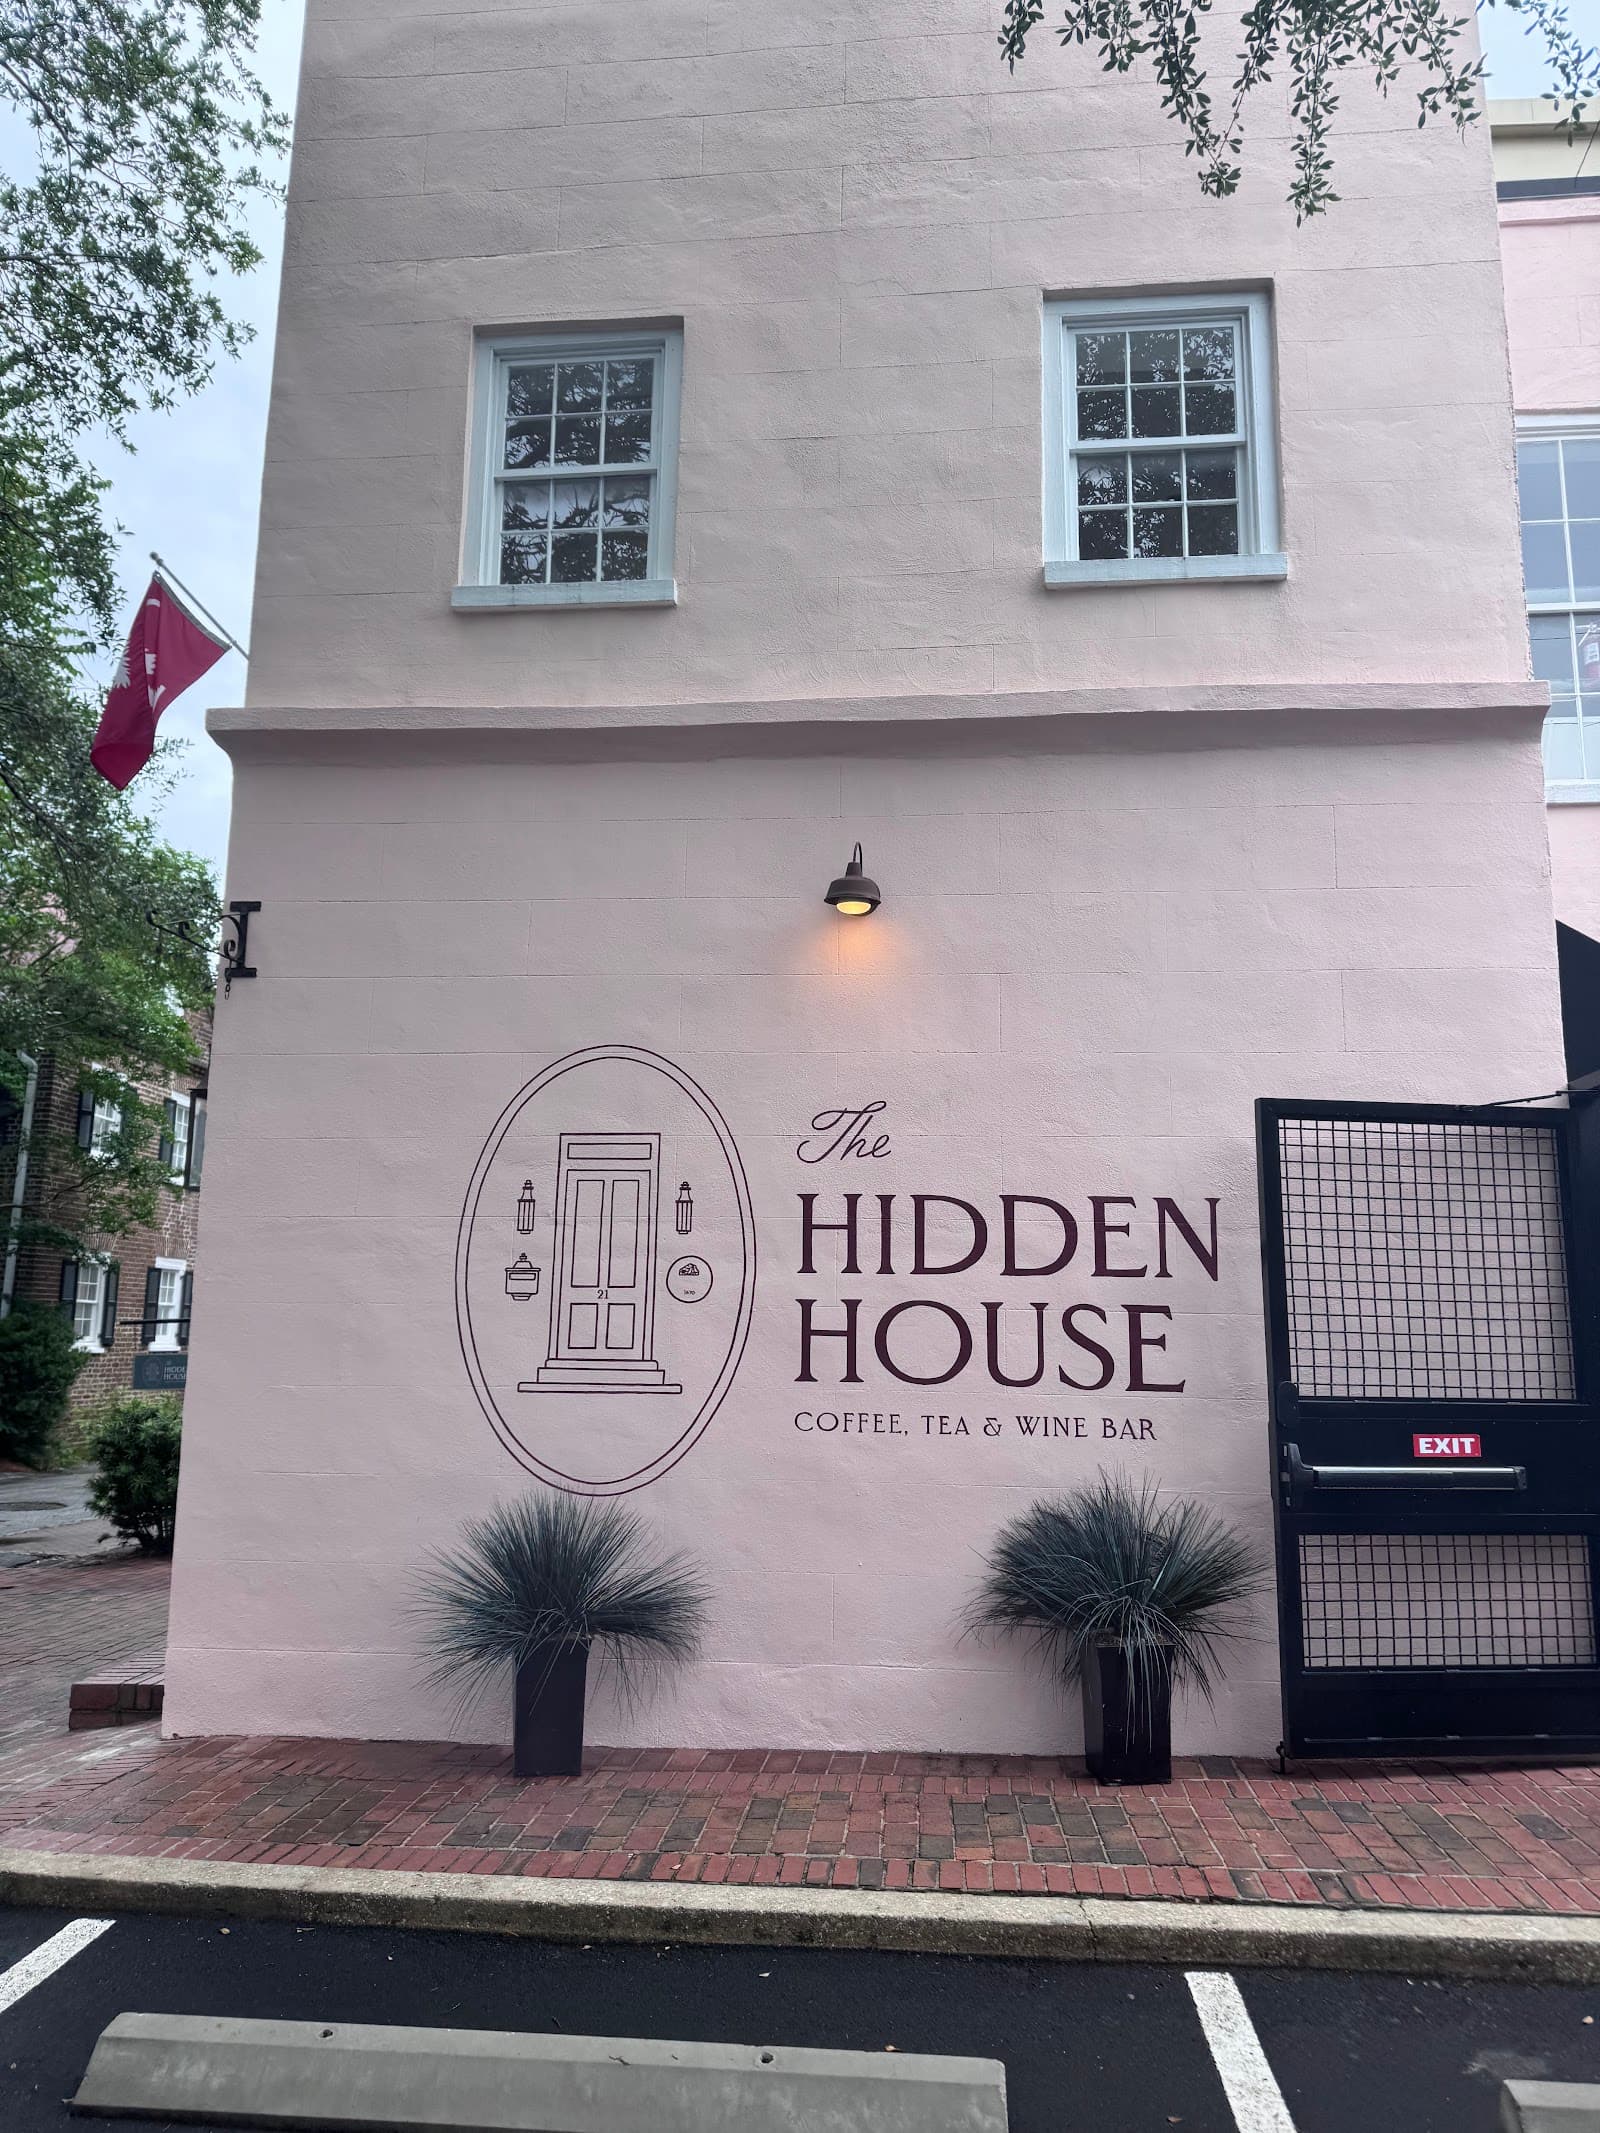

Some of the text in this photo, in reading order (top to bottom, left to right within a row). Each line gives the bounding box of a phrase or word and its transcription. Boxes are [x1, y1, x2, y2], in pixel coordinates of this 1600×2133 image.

[796, 1100, 892, 1164] The
[796, 1193, 1222, 1282] HIDDEN
[597, 1289, 608, 1300] 21
[794, 1298, 1186, 1393] HOUSE
[794, 1411, 1158, 1441] COFFEE, TEA & WINE BAR
[1419, 1437, 1475, 1454] EXIT
